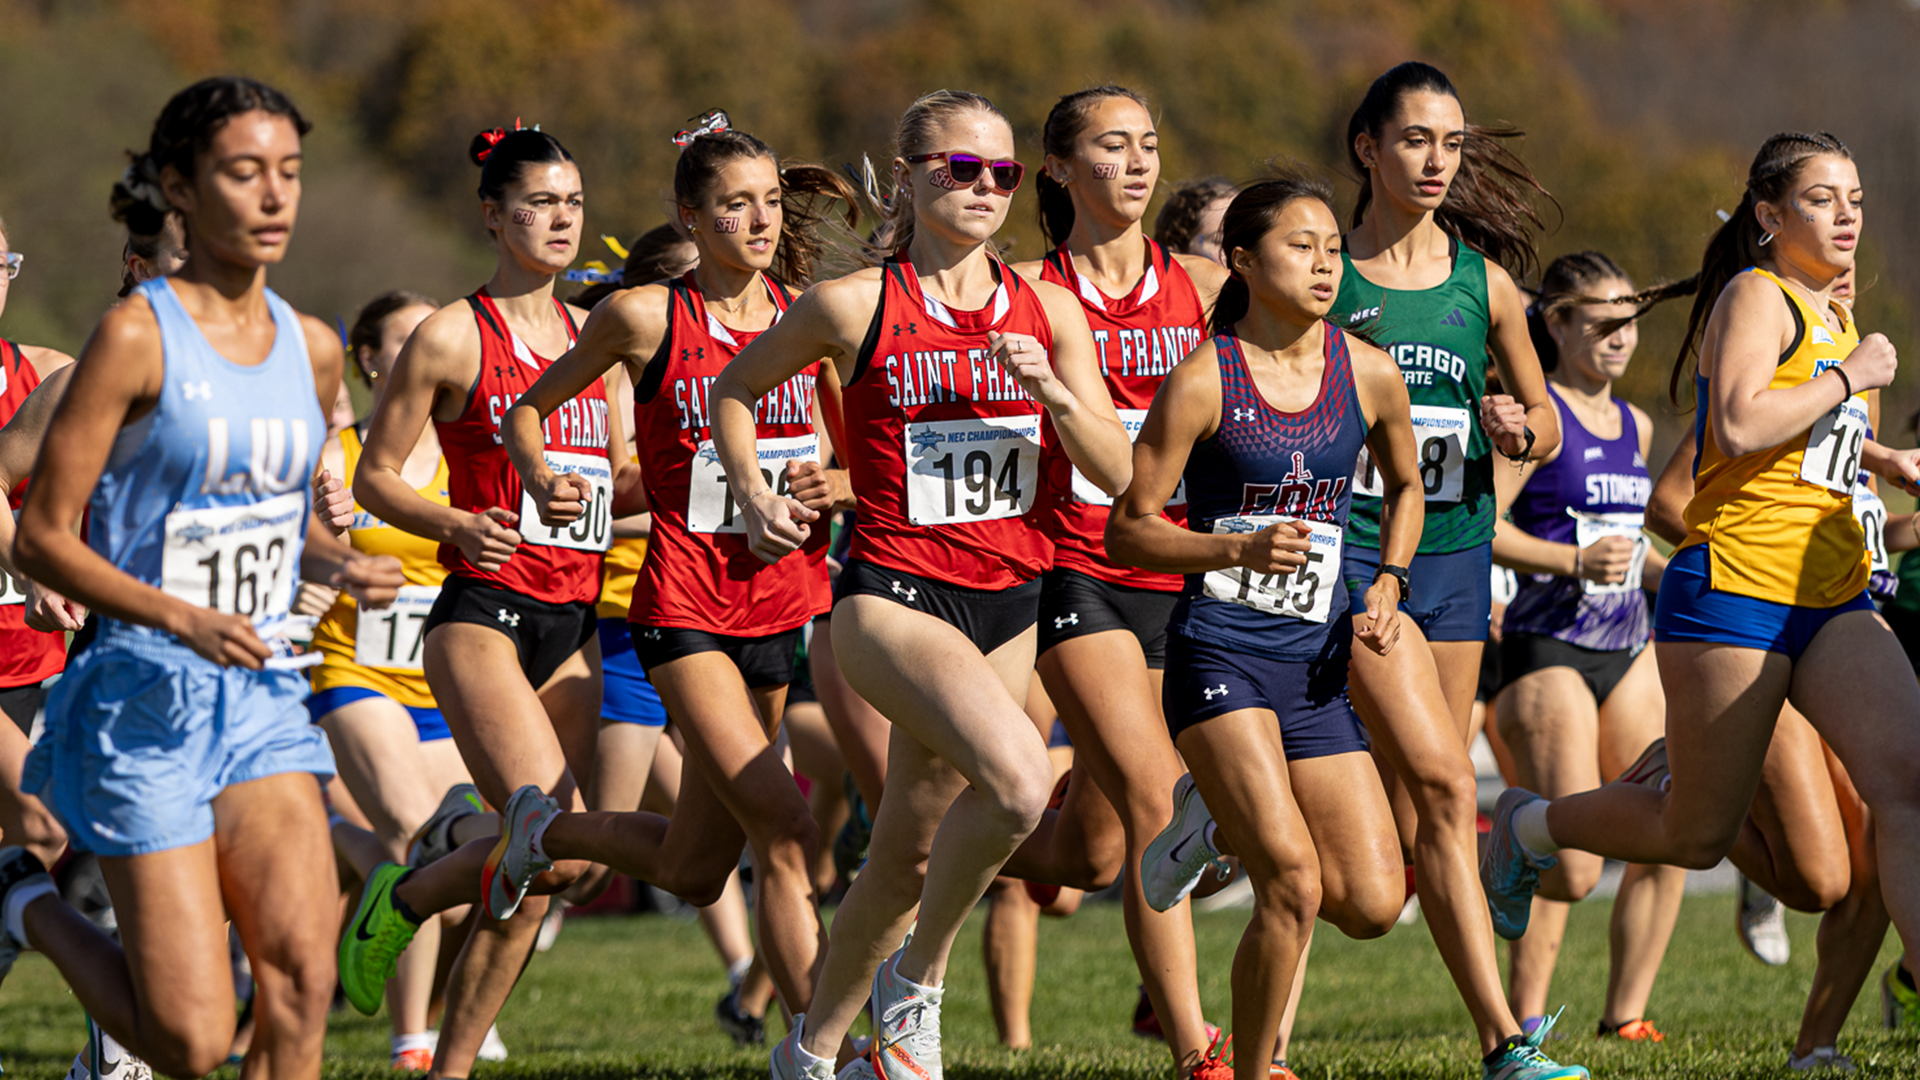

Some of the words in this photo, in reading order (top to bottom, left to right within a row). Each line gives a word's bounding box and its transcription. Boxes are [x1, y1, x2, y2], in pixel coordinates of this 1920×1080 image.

[1093, 162, 1119, 180] SFU
[513, 208, 536, 226] SFU
[715, 216, 740, 234] SFU
[1350, 306, 1380, 323] NEC
[886, 351, 957, 407] SAINT
[1812, 360, 1844, 379] NE
[675, 375, 717, 430] SAI
[947, 432, 966, 444] NEC
[966, 427, 1036, 442] CHAMPIONSHIPS
[202, 418, 309, 494] LIU
[932, 447, 1022, 517] 194
[1237, 476, 1348, 524] FDU
[1236, 551, 1325, 613] 145
